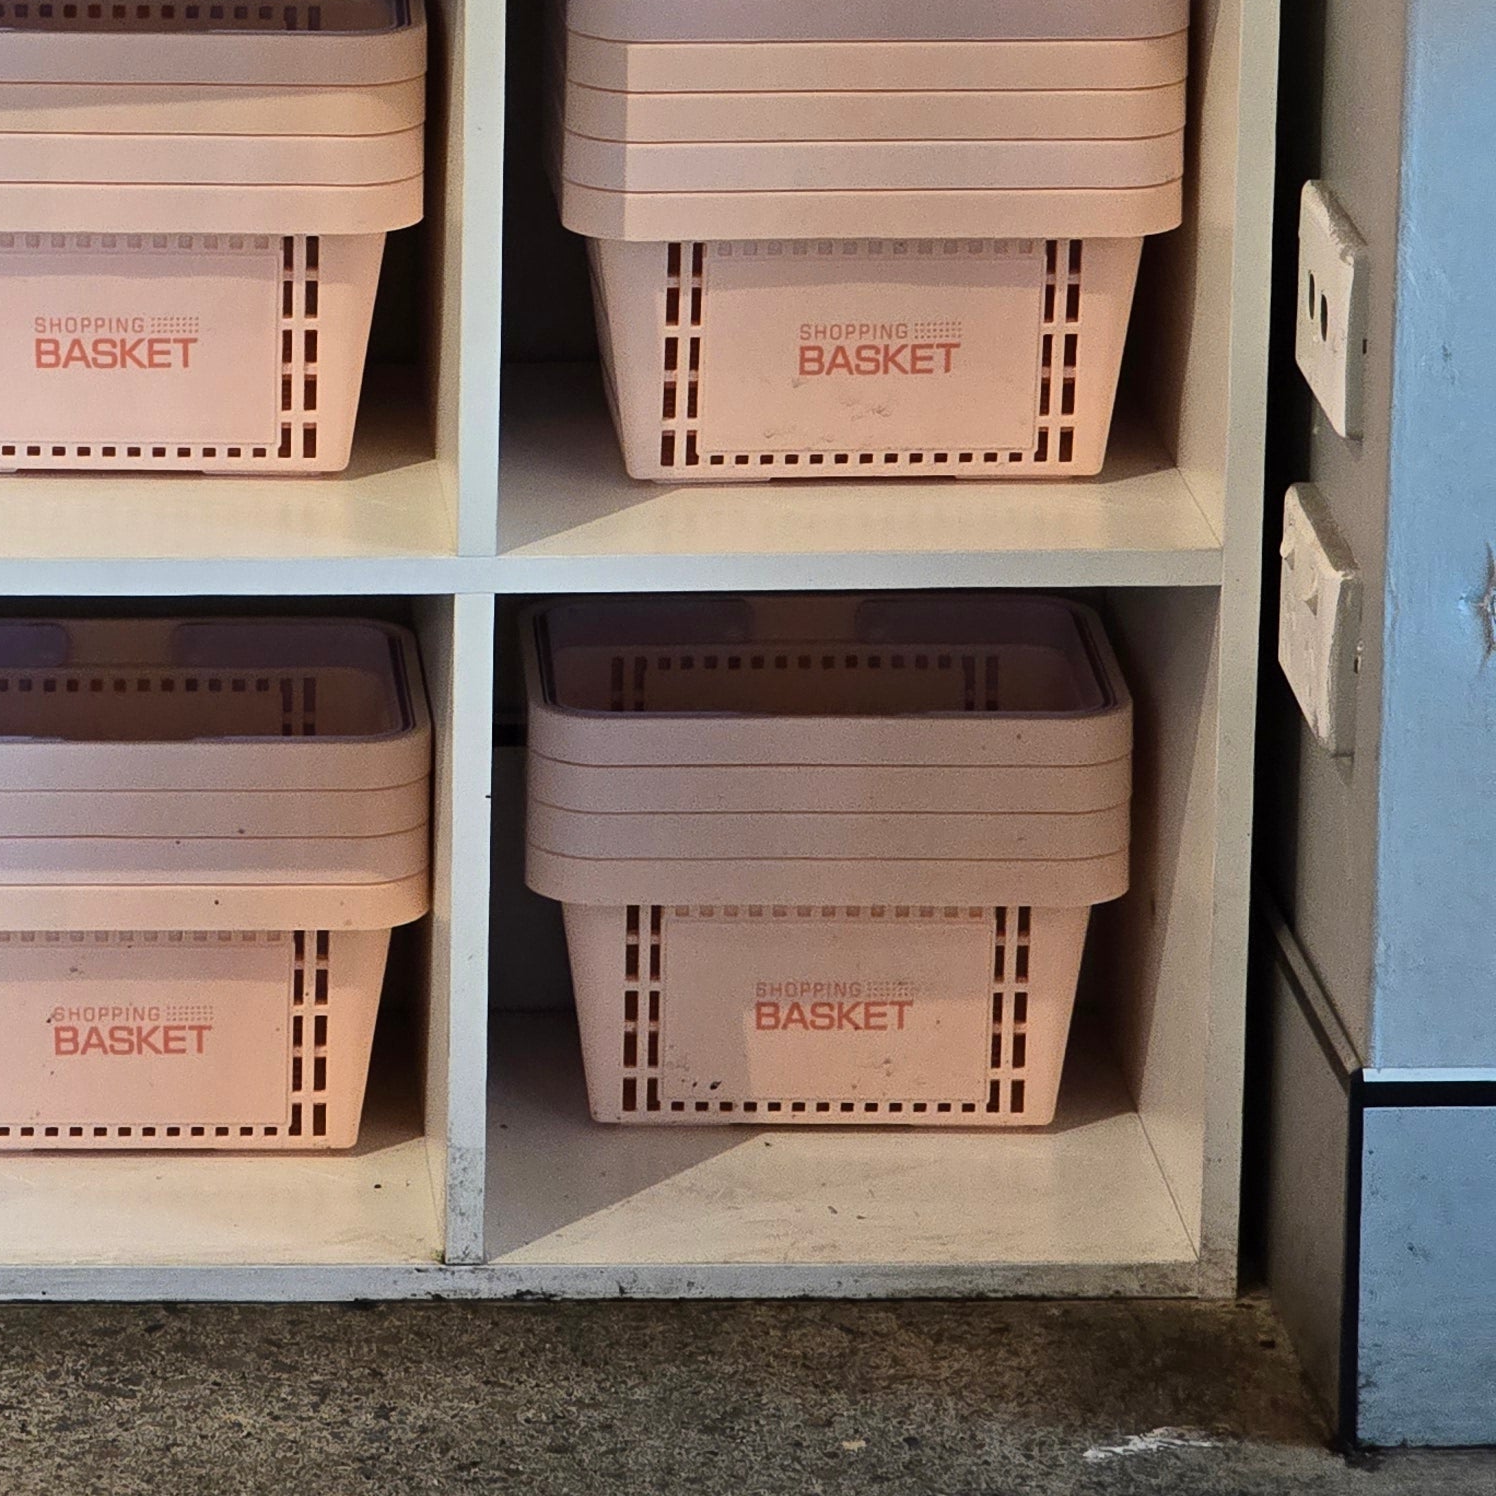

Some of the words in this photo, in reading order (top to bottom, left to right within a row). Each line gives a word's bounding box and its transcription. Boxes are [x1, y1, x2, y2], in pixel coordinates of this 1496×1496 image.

[34, 316, 145, 335] SHOPPING
[799, 323, 909, 341] SHOPPING
[35, 337, 197, 369] BASKET
[799, 342, 961, 376] BASKET
[755, 981, 862, 999] SHOPPING
[53, 1005, 162, 1023] SHOPPING
[756, 1000, 913, 1031] BASKET
[55, 1025, 212, 1055] BASKET
